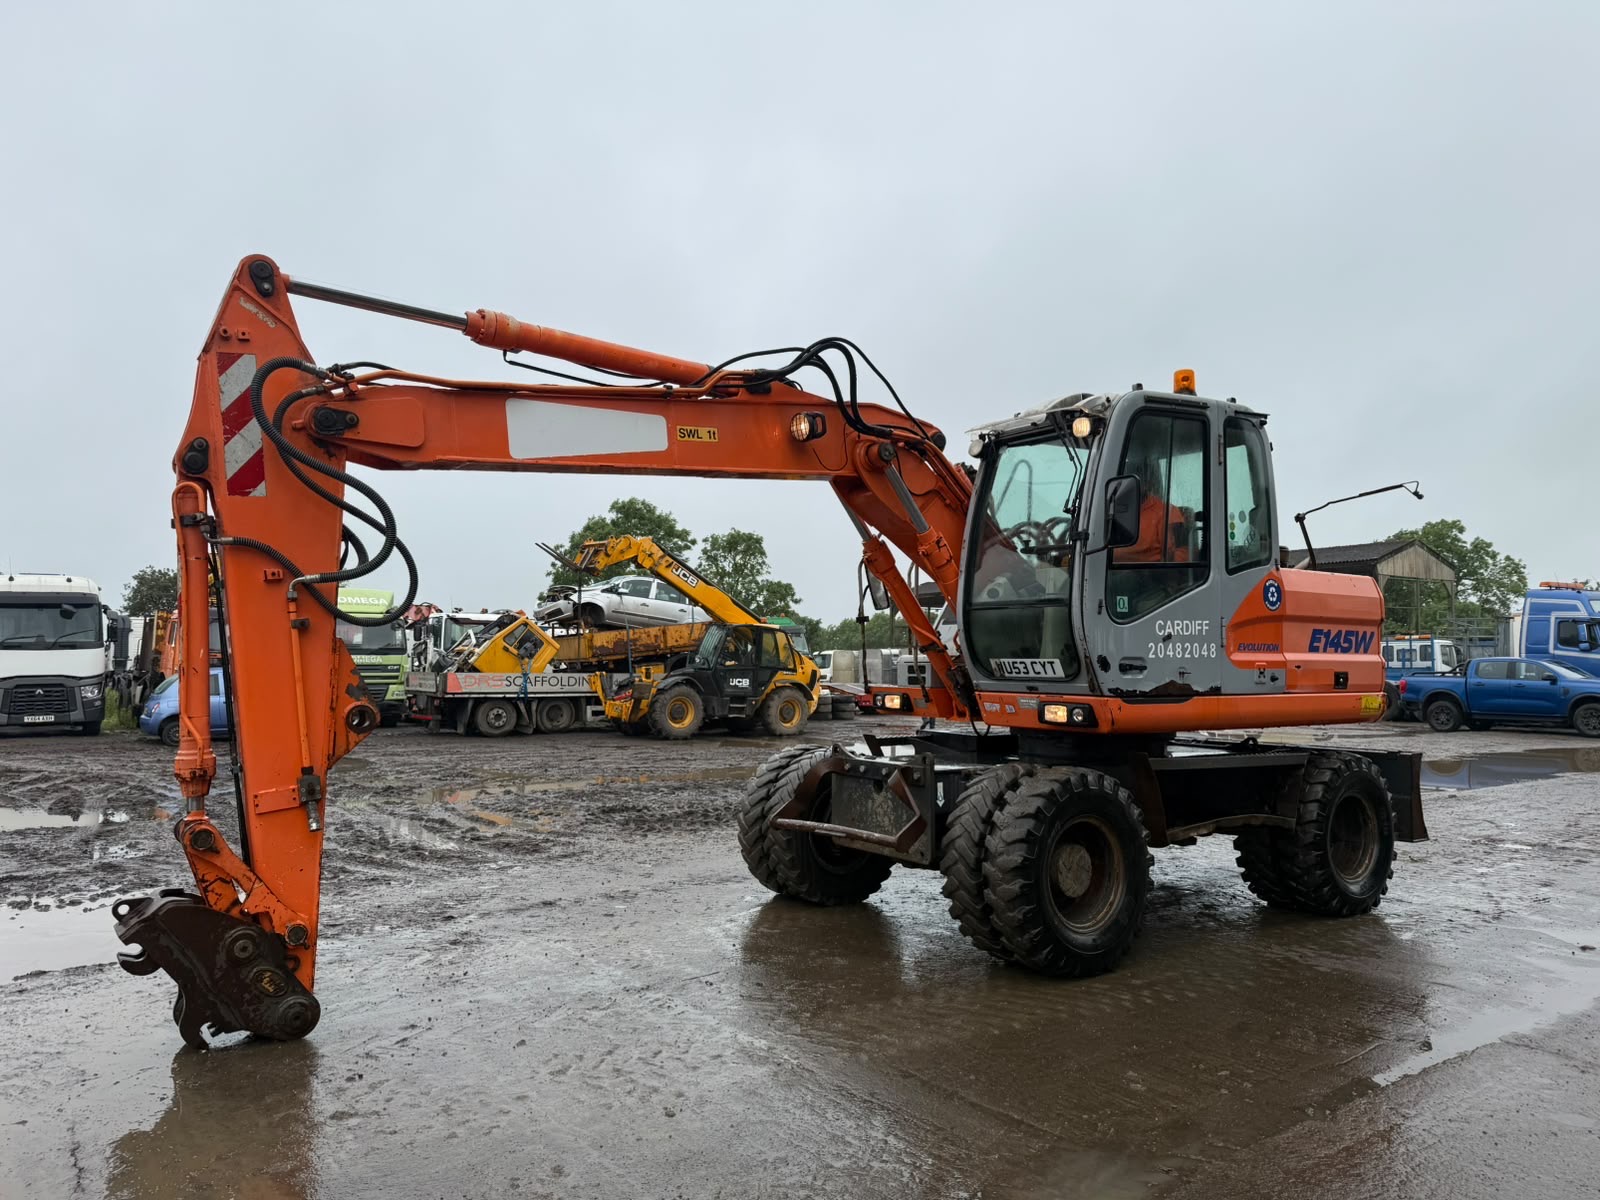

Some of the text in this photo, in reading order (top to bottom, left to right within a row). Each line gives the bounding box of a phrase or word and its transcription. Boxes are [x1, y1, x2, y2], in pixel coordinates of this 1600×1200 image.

[678, 428, 717, 440] SWL 1t
[672, 564, 698, 588] JCB
[337, 596, 389, 605] OMEGA
[1155, 620, 1210, 636] CARDIFF
[1237, 642, 1280, 652] EVOLUTION
[1308, 628, 1375, 654] E145W
[1148, 642, 1217, 658] 20482048
[1030, 660, 1057, 675] CYT
[464, 674, 590, 689] DRS SCAFFOLDIN
[730, 678, 750, 686] JCB
